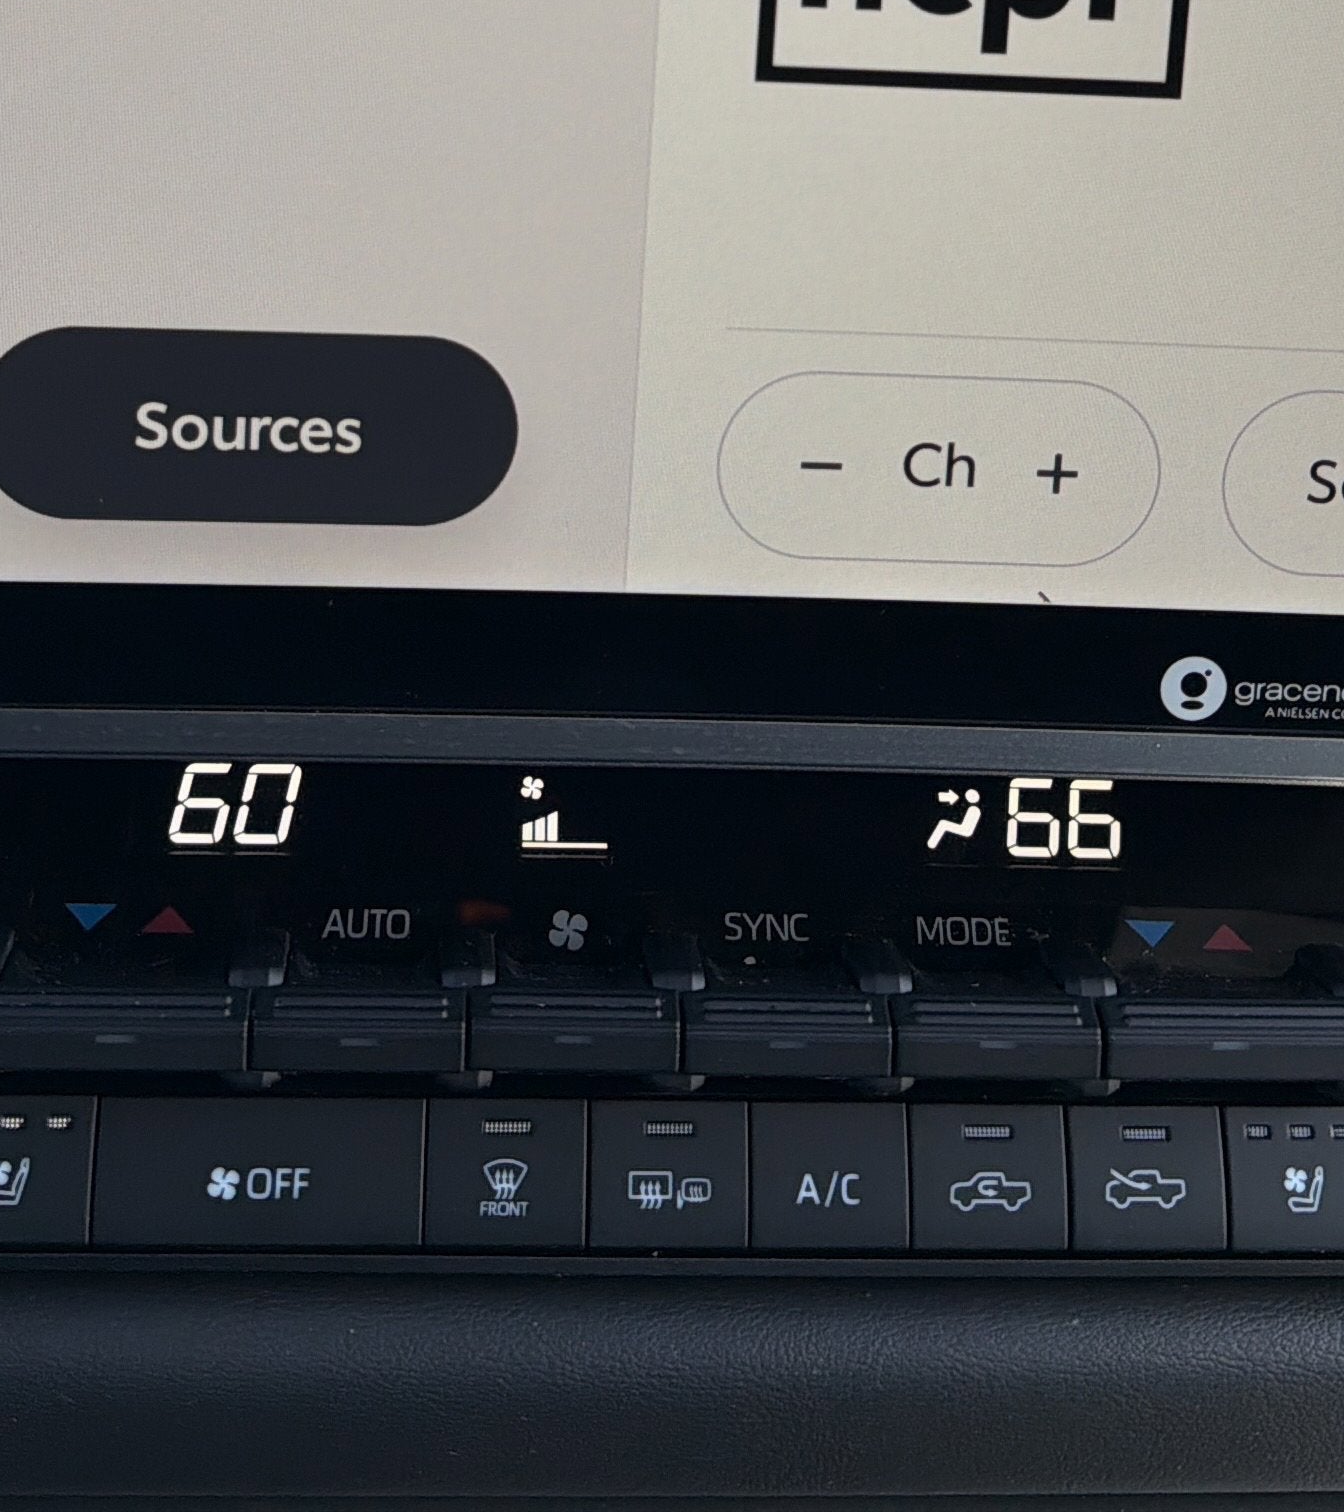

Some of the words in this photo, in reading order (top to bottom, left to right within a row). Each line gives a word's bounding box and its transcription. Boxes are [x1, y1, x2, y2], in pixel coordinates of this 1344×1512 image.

[136, 402, 361, 453] Sources
[904, 442, 975, 487] Ch
[1265, 707, 1275, 717] A
[1277, 707, 1330, 719] NIELSEN
[169, 763, 302, 844] 60
[1007, 778, 1120, 859] 66
[322, 909, 410, 939] AUTO
[725, 912, 809, 941] SYNC
[917, 916, 1011, 945] MODE
[247, 1168, 309, 1199] OFF
[797, 1172, 859, 1206] A/C
[479, 1200, 529, 1217] FRONT
